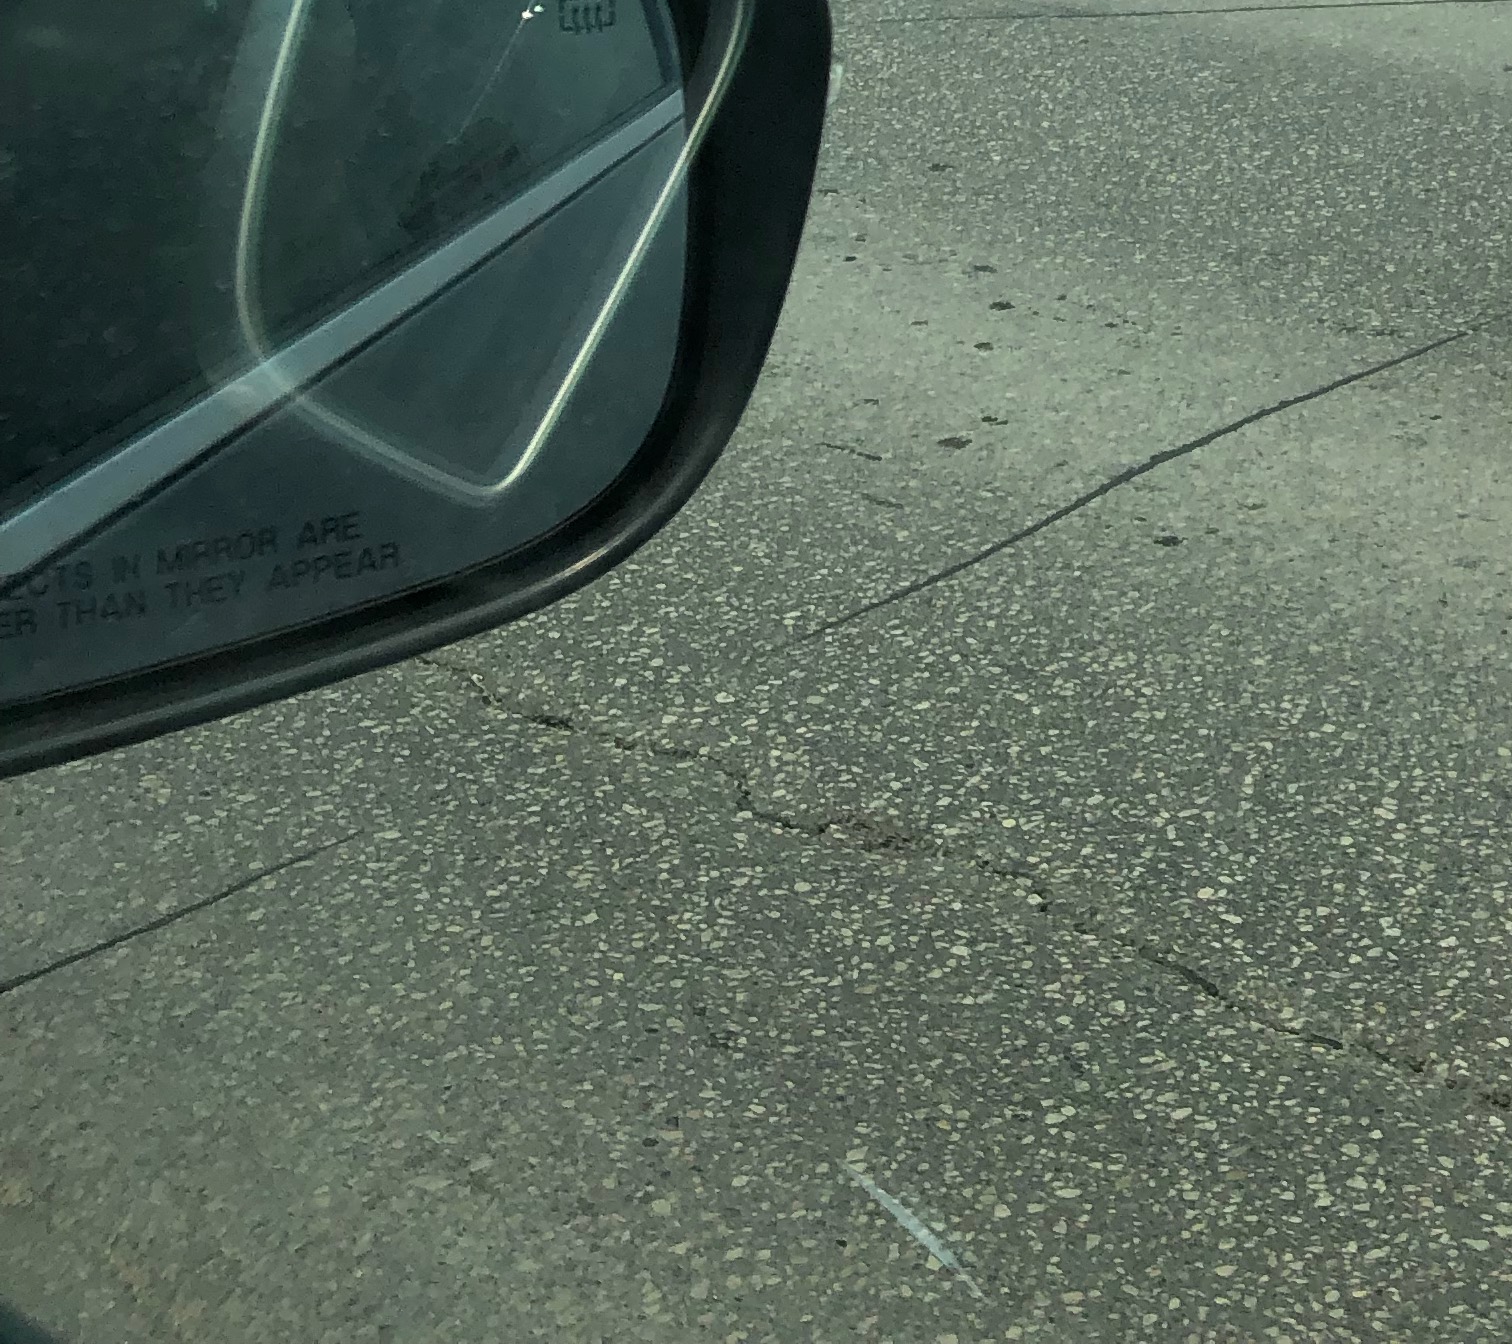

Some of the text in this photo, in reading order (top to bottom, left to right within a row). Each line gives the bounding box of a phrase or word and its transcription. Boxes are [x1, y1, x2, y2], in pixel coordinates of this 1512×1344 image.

[156, 524, 280, 576] MIRROR
[296, 510, 364, 551] ARE
[57, 590, 147, 629] THAN
[165, 569, 246, 609] THEY
[267, 540, 401, 591] APPEAR
